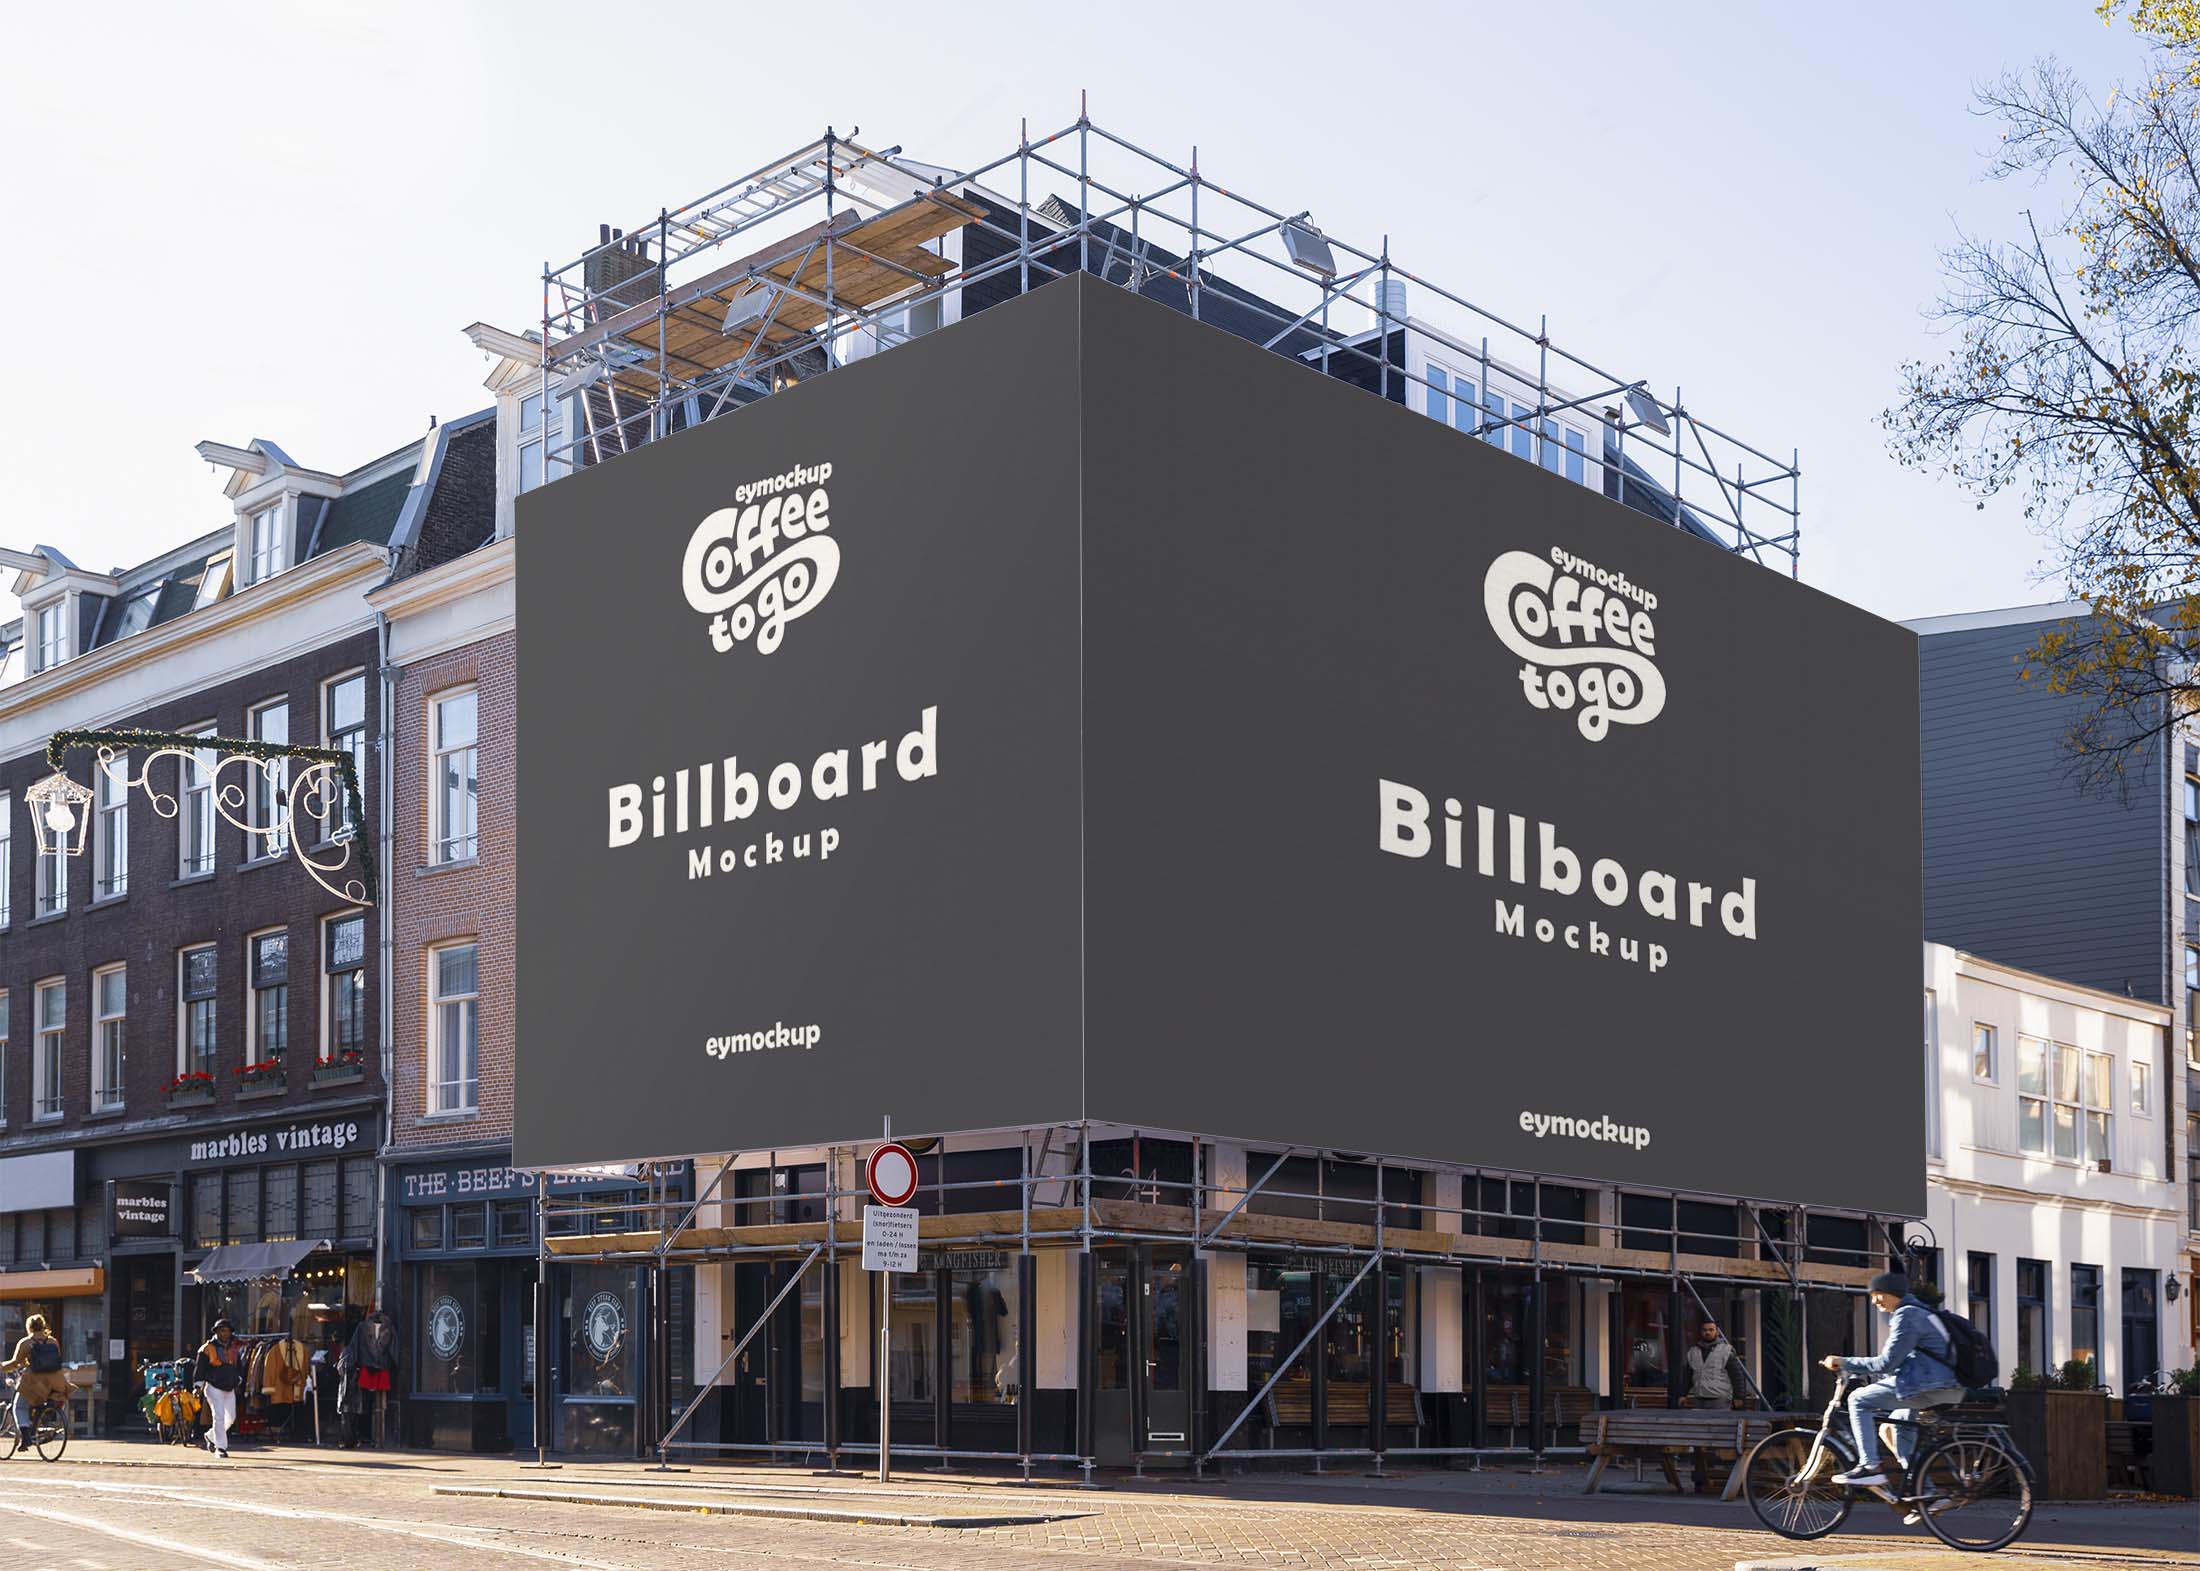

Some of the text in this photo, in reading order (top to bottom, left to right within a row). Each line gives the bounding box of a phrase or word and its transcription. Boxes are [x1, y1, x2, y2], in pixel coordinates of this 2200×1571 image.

[735, 462, 833, 505] eymockup
[1550, 546, 1658, 612] eymockup
[608, 705, 938, 849] Billboard
[688, 827, 840, 881] Mockup
[1379, 778, 1757, 940] Billboard
[1495, 899, 1668, 973] Mockup
[705, 1021, 821, 1060] eymockup
[190, 1122, 357, 1161] marbles vintage
[1519, 1111, 1651, 1151] eymockup
[405, 1173, 447, 1197] THE
[116, 1197, 167, 1208] marbles
[118, 1209, 165, 1223] vintage
[872, 1210, 913, 1220] Uitgezonderd
[872, 1220, 913, 1230] (snor)fietsers
[881, 1230, 898, 1238] 0-24
[876, 1240, 894, 1248] laden
[932, 1250, 1001, 1269] KNGFISHER
[882, 1260, 897, 1268] 9-12
